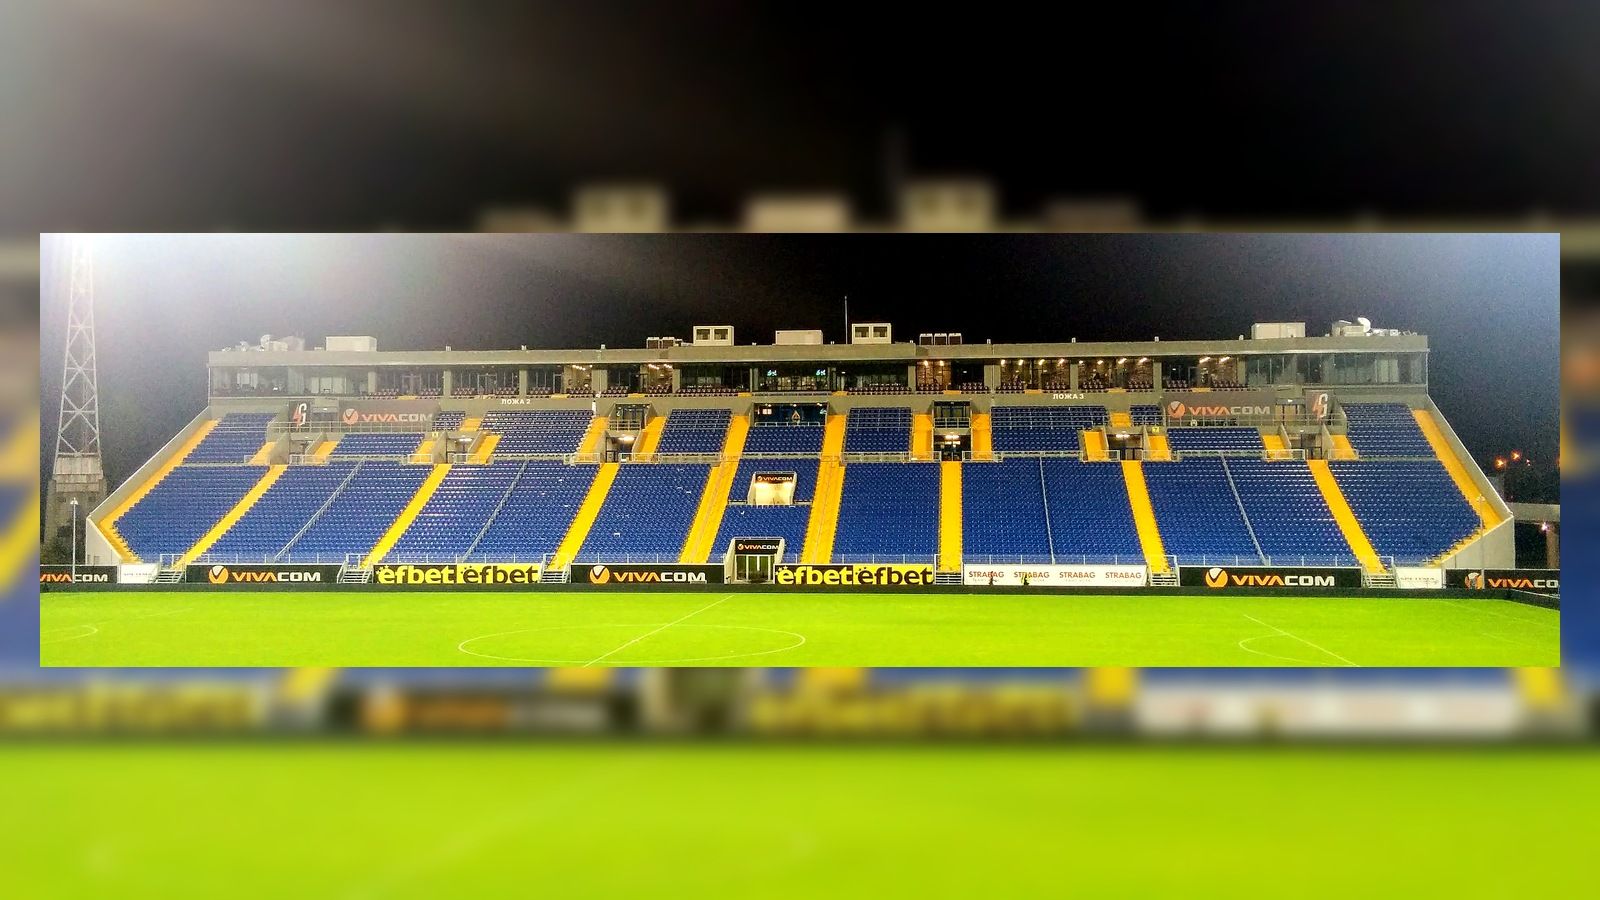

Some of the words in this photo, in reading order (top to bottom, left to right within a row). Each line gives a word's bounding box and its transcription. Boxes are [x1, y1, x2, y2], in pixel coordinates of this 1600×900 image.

[1188, 405, 1270, 416] VIVACOM
[361, 414, 433, 422] VIVACOM
[232, 572, 320, 582] VIVACOM
[378, 566, 456, 584] efbet
[462, 566, 538, 584] efbet
[613, 572, 706, 582] VIVACOM
[777, 566, 853, 584] efbet
[857, 566, 934, 584] efbet
[1232, 575, 1335, 586] VIVACOM
